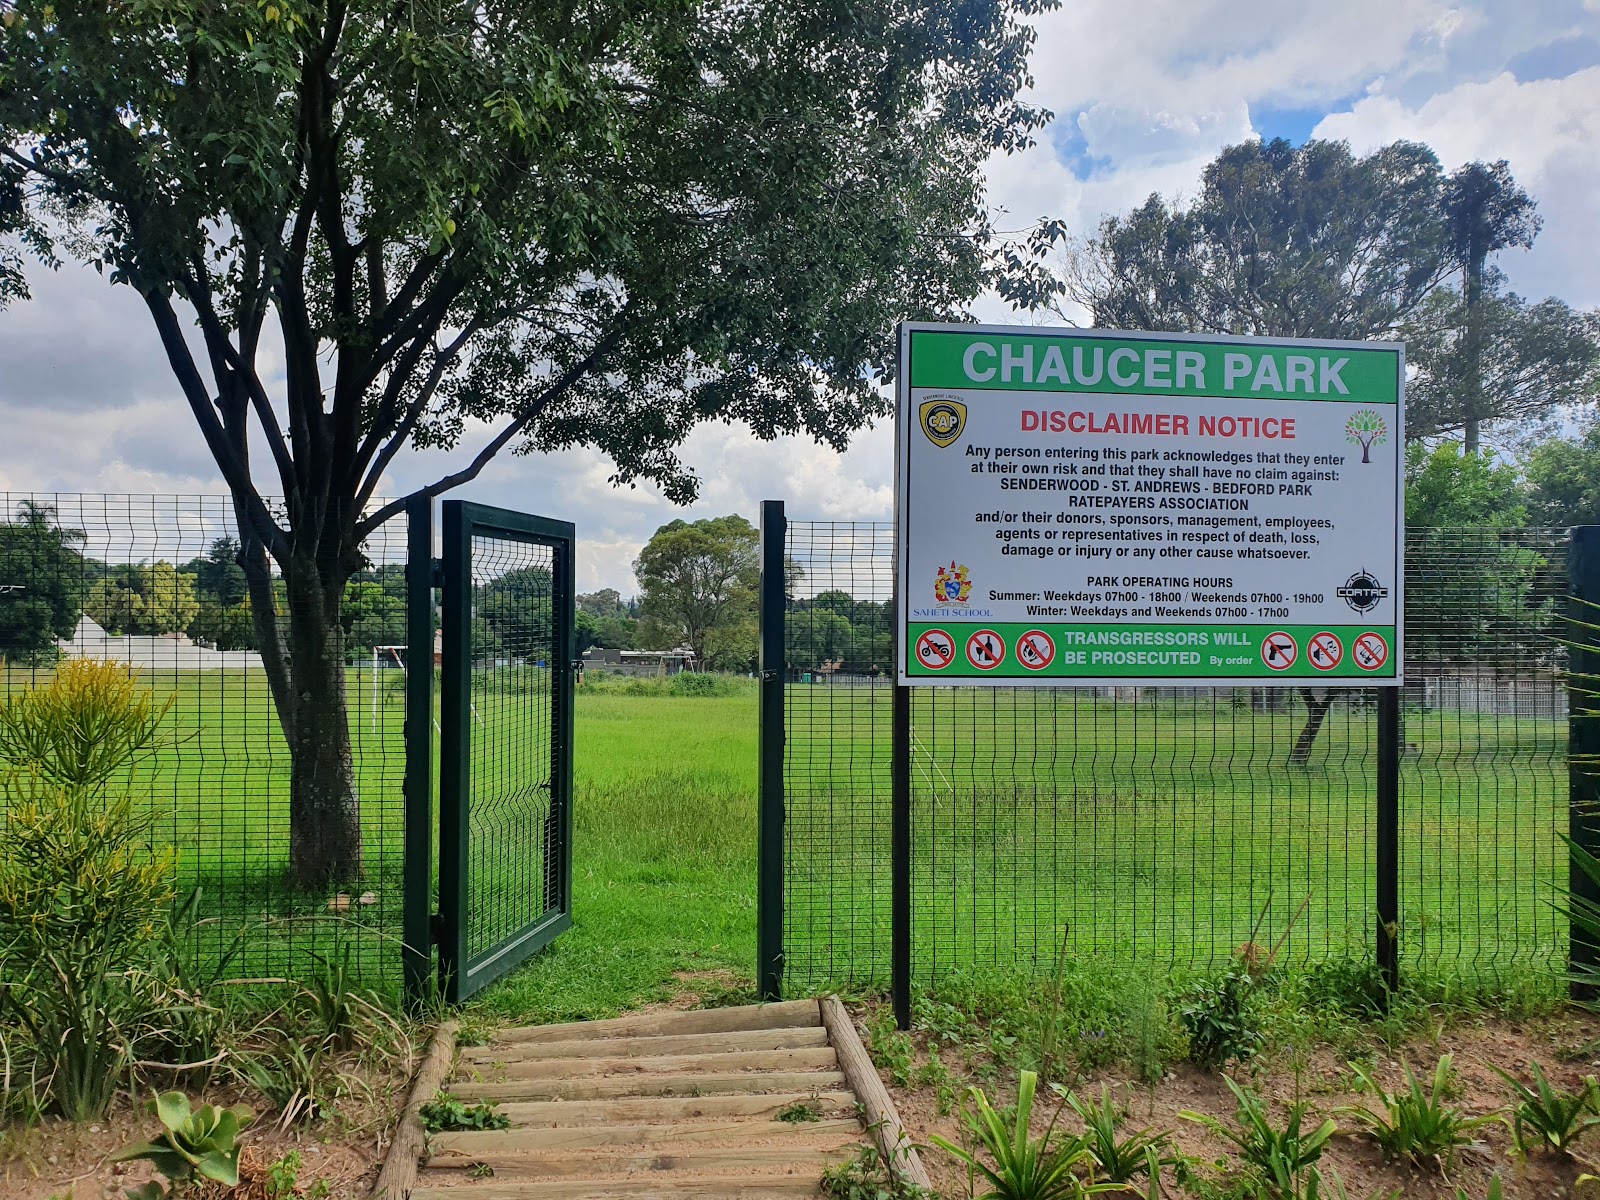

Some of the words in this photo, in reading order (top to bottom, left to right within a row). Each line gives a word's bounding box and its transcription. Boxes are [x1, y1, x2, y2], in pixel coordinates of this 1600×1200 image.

[963, 342, 1206, 389] CHAUCER
[1224, 353, 1350, 394] PARK
[929, 415, 958, 428] CAP
[1022, 411, 1188, 435] DISCLAIMER
[1199, 416, 1295, 438] NOTICE
[966, 445, 990, 459] Any
[995, 448, 1040, 461] person
[1045, 447, 1098, 461] entering
[1103, 448, 1126, 459] this
[1131, 449, 1159, 462] park
[1163, 450, 1252, 465] acknowledges
[1257, 452, 1280, 463] that
[1284, 453, 1310, 467] they
[1314, 455, 1344, 465] enter
[972, 462, 983, 472] at
[988, 462, 1018, 473] their
[1022, 465, 1048, 473] own
[1054, 463, 1077, 474] risk
[1082, 464, 1105, 475] and
[1110, 464, 1134, 475] that
[1138, 465, 1165, 479] they
[1169, 466, 1198, 477] shall
[1203, 467, 1231, 478] have
[1237, 470, 1251, 478] no
[1255, 468, 1287, 479] claim
[1292, 471, 1338, 483] against:
[1001, 478, 1099, 491] SENDERWOOD
[1112, 480, 1129, 491] ST.
[1134, 481, 1200, 493] ANDREWS
[1213, 483, 1274, 494] BEDFORD
[1279, 484, 1312, 495] PARK
[1070, 496, 1154, 508] RATEPAYERS
[1159, 498, 1248, 510] ASSOCIATION
[976, 511, 1018, 523] and/or
[1022, 511, 1052, 522] their
[1057, 512, 1105, 524] donors,
[1110, 516, 1173, 527] sponsors,
[1178, 516, 1261, 528] management,
[1266, 516, 1334, 530] employees,
[996, 528, 1040, 541] agents
[1045, 531, 1058, 539] or
[1063, 530, 1162, 542] representatives
[1167, 533, 1177, 541] in
[1183, 532, 1229, 544] respect
[1233, 531, 1245, 542] of
[1249, 532, 1286, 545] death,
[1292, 532, 1319, 545] loss,
[1002, 544, 1053, 558] damage
[1058, 547, 1071, 555] or
[1076, 545, 1112, 559] injury
[1116, 548, 1129, 556] or
[1134, 548, 1155, 560] any
[1160, 546, 1192, 557] other
[1197, 549, 1233, 558] cause
[1237, 547, 1310, 559] whatsoever.
[1088, 577, 1118, 586] PARK
[1123, 577, 1189, 587] OPERATING
[1194, 578, 1232, 587] HOURS
[989, 590, 1039, 600] Summer:
[1044, 591, 1101, 603] Weekdays
[1105, 592, 1138, 601] 07h00
[1150, 592, 1181, 602] 18h00
[1192, 592, 1247, 602] Weekends
[1251, 593, 1282, 602] 07h00
[1294, 594, 1323, 603] 19h00
[1338, 588, 1388, 598] CORTAC
[1027, 606, 1066, 615] Winter:
[1071, 606, 1127, 618] Weekdays
[1132, 607, 1151, 616] and
[1155, 607, 1211, 616] Weekends
[1215, 607, 1247, 617] 07h00
[1258, 608, 1288, 617] 17h00
[1065, 632, 1208, 645] TRANSGRESSORS
[1213, 633, 1251, 645] WILL
[1065, 651, 1086, 664] BE
[1092, 652, 1200, 664] PROSECUTED
[1210, 656, 1223, 666] By
[1226, 656, 1253, 664] order
